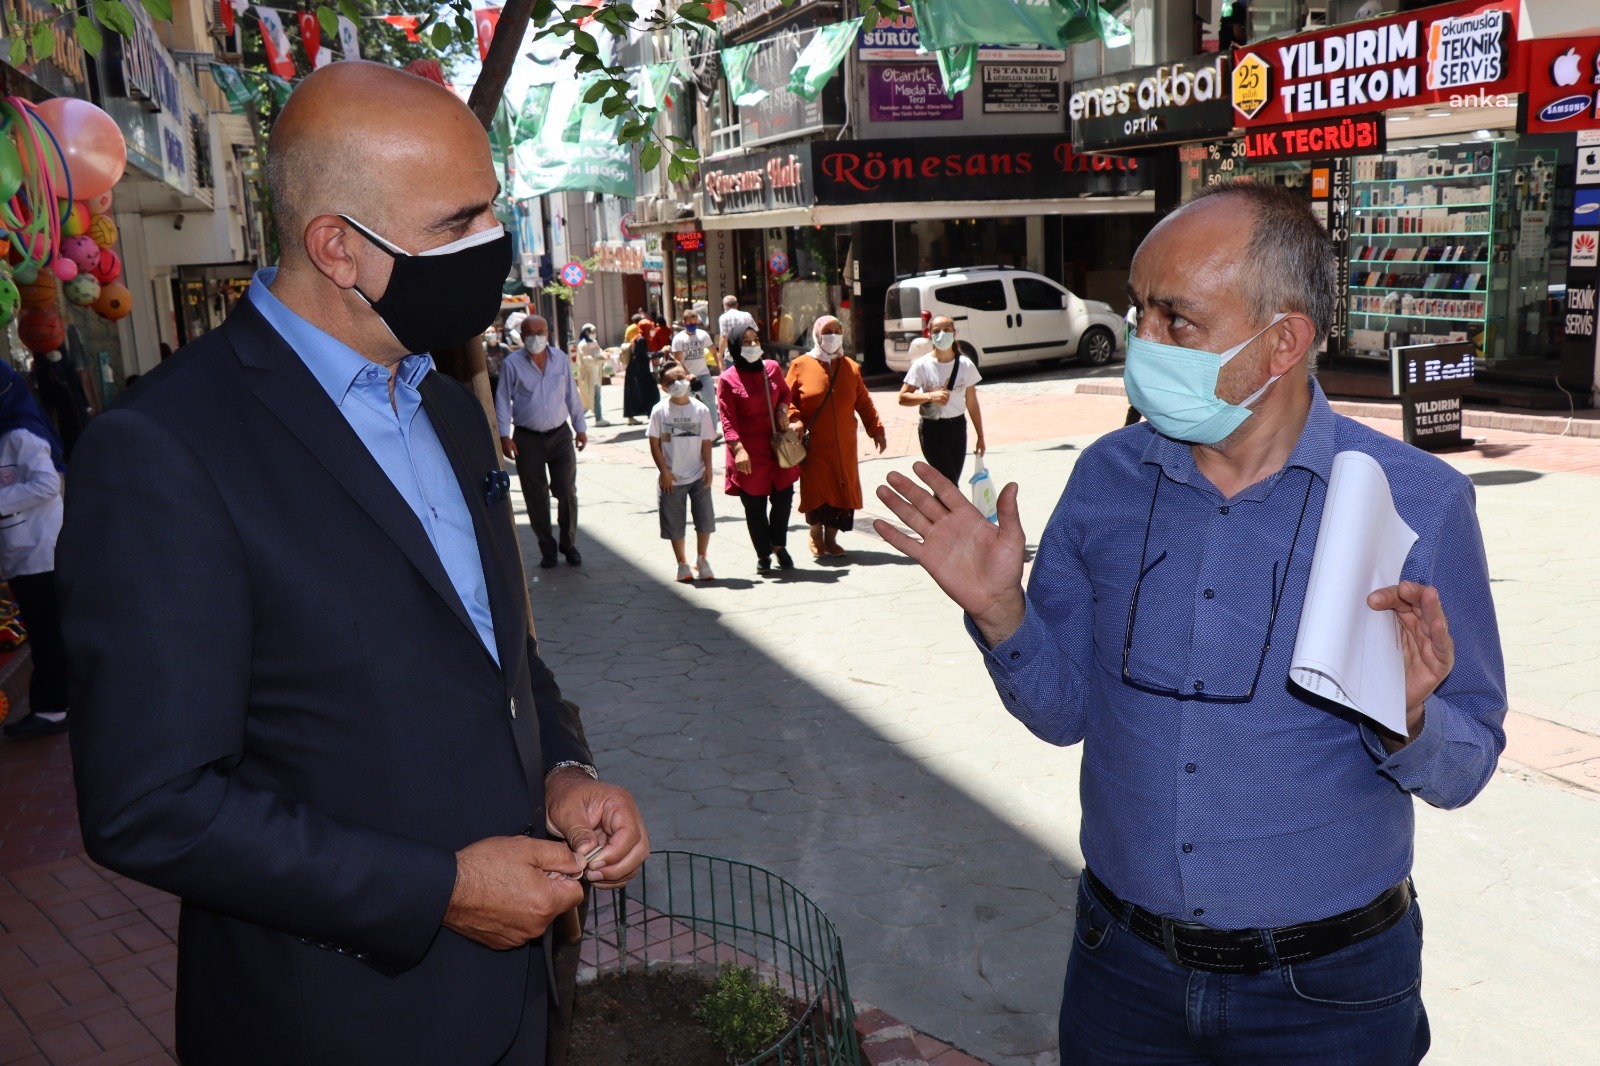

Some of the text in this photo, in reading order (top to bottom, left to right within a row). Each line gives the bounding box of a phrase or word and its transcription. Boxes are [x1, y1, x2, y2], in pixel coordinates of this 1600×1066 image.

[863, 29, 920, 46] SÜRÜC
[1279, 20, 1418, 80] YILDIRIM
[882, 66, 936, 82] Otantik
[1239, 64, 1259, 89] 25
[894, 83, 949, 96] Moda Ev
[1069, 56, 1226, 120] enes akbal
[1280, 65, 1417, 114] TELEKOM
[1547, 102, 1586, 114] SAMSUNG
[1245, 118, 1377, 157] LIK TECRÜB
[1232, 142, 1247, 157] 30
[821, 151, 1032, 191] Rönesans
[1221, 158, 1234, 171] 40
[1208, 173, 1222, 186] 50
[1567, 285, 1596, 310] TEKNİK
[1564, 310, 1593, 336] SERVİS
[1414, 399, 1460, 414] YILDIRIM
[1415, 411, 1460, 426] TELEKOM
[1434, 423, 1460, 433] YILDIRIM
